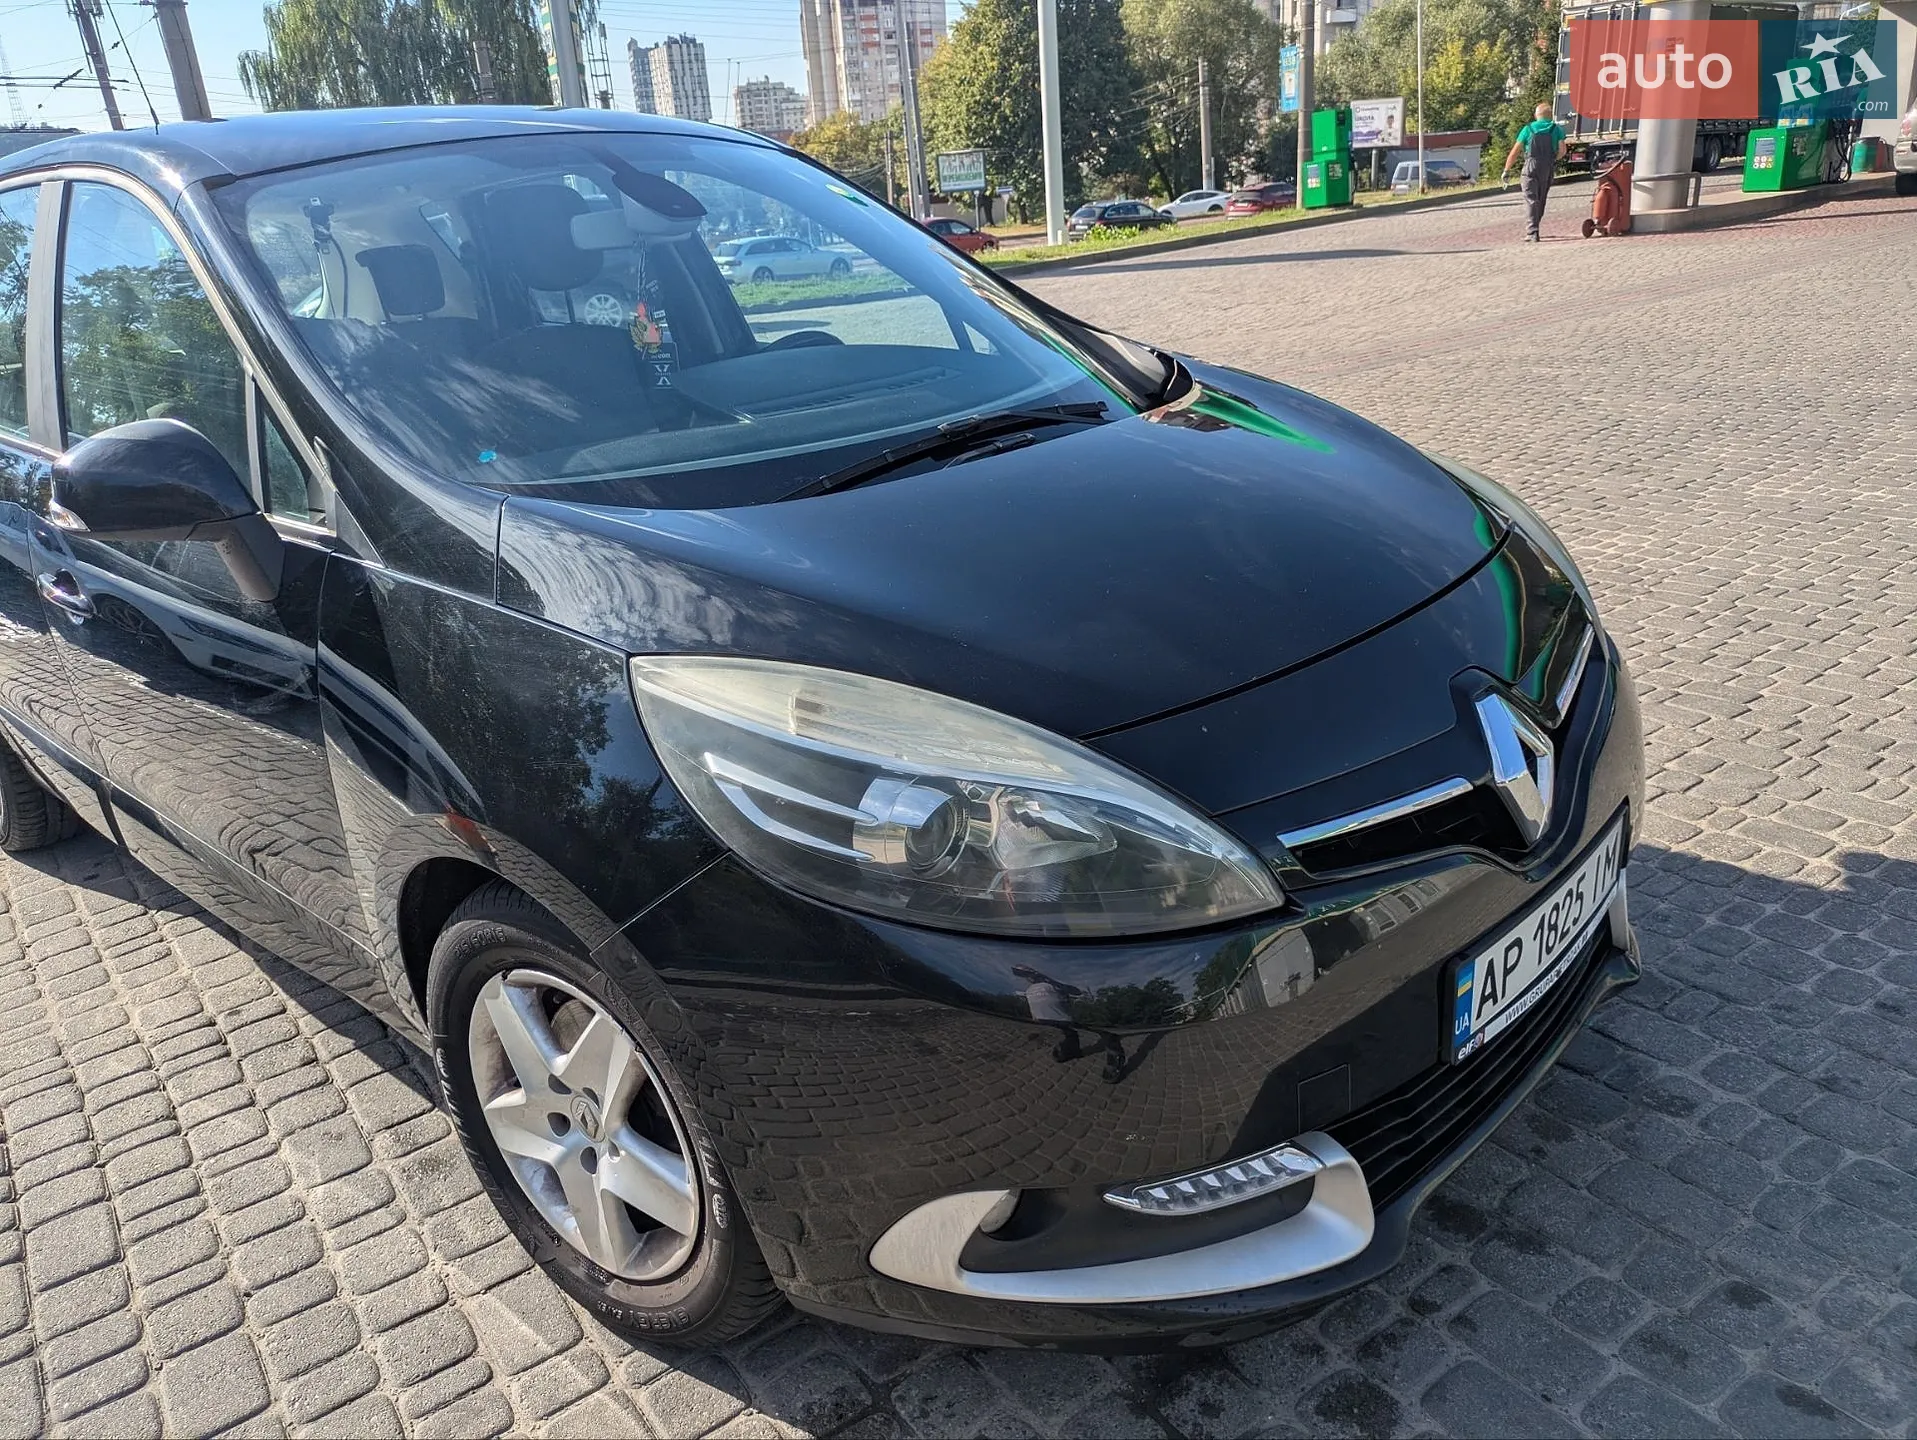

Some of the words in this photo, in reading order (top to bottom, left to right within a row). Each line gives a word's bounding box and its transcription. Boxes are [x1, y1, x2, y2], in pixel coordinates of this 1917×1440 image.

[1475, 936, 1523, 1020] AP
[1533, 872, 1586, 966] 1825
[1592, 831, 1619, 903] IM
[1455, 1012, 1469, 1035] UA
[1458, 1038, 1475, 1060] elf
